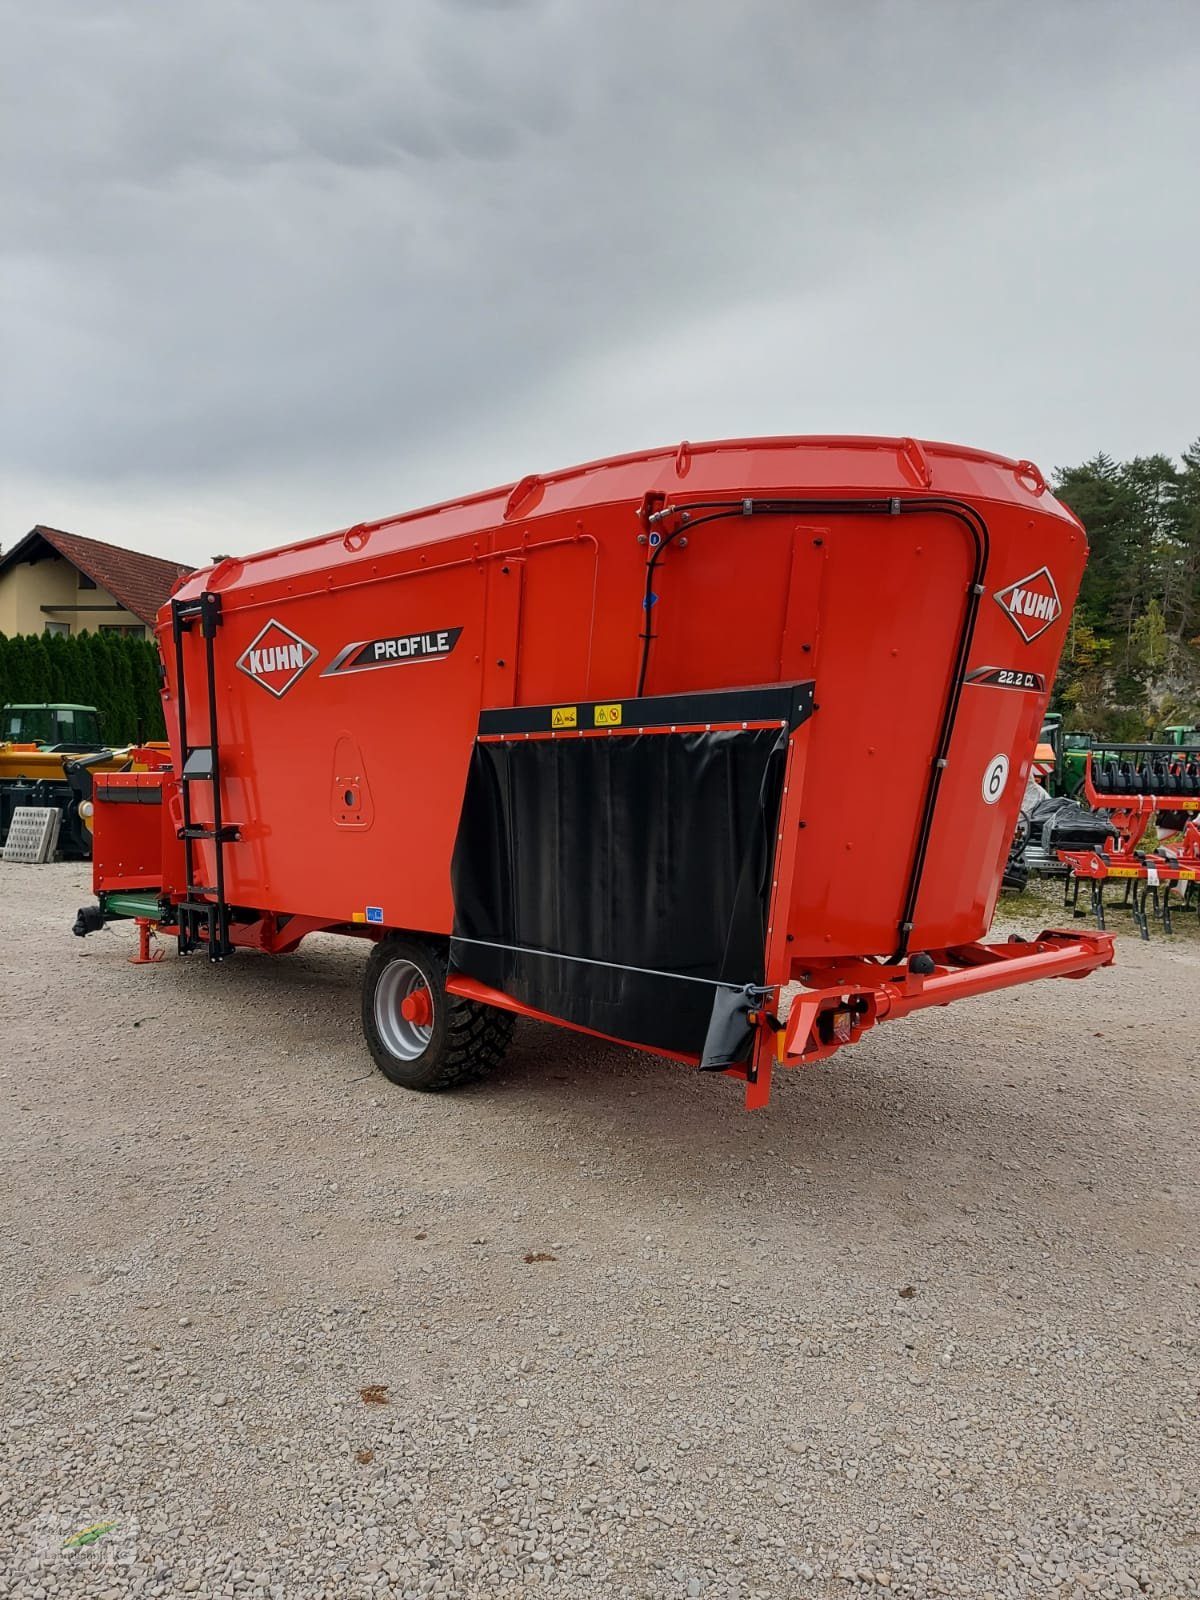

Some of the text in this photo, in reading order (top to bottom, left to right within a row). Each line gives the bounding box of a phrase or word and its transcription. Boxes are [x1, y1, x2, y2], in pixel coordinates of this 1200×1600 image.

[1009, 588, 1056, 622] KUHN
[249, 643, 304, 675] KUHN
[374, 632, 450, 660] PROFILE
[998, 670, 1023, 686] 22.2
[989, 765, 1003, 795] 6
